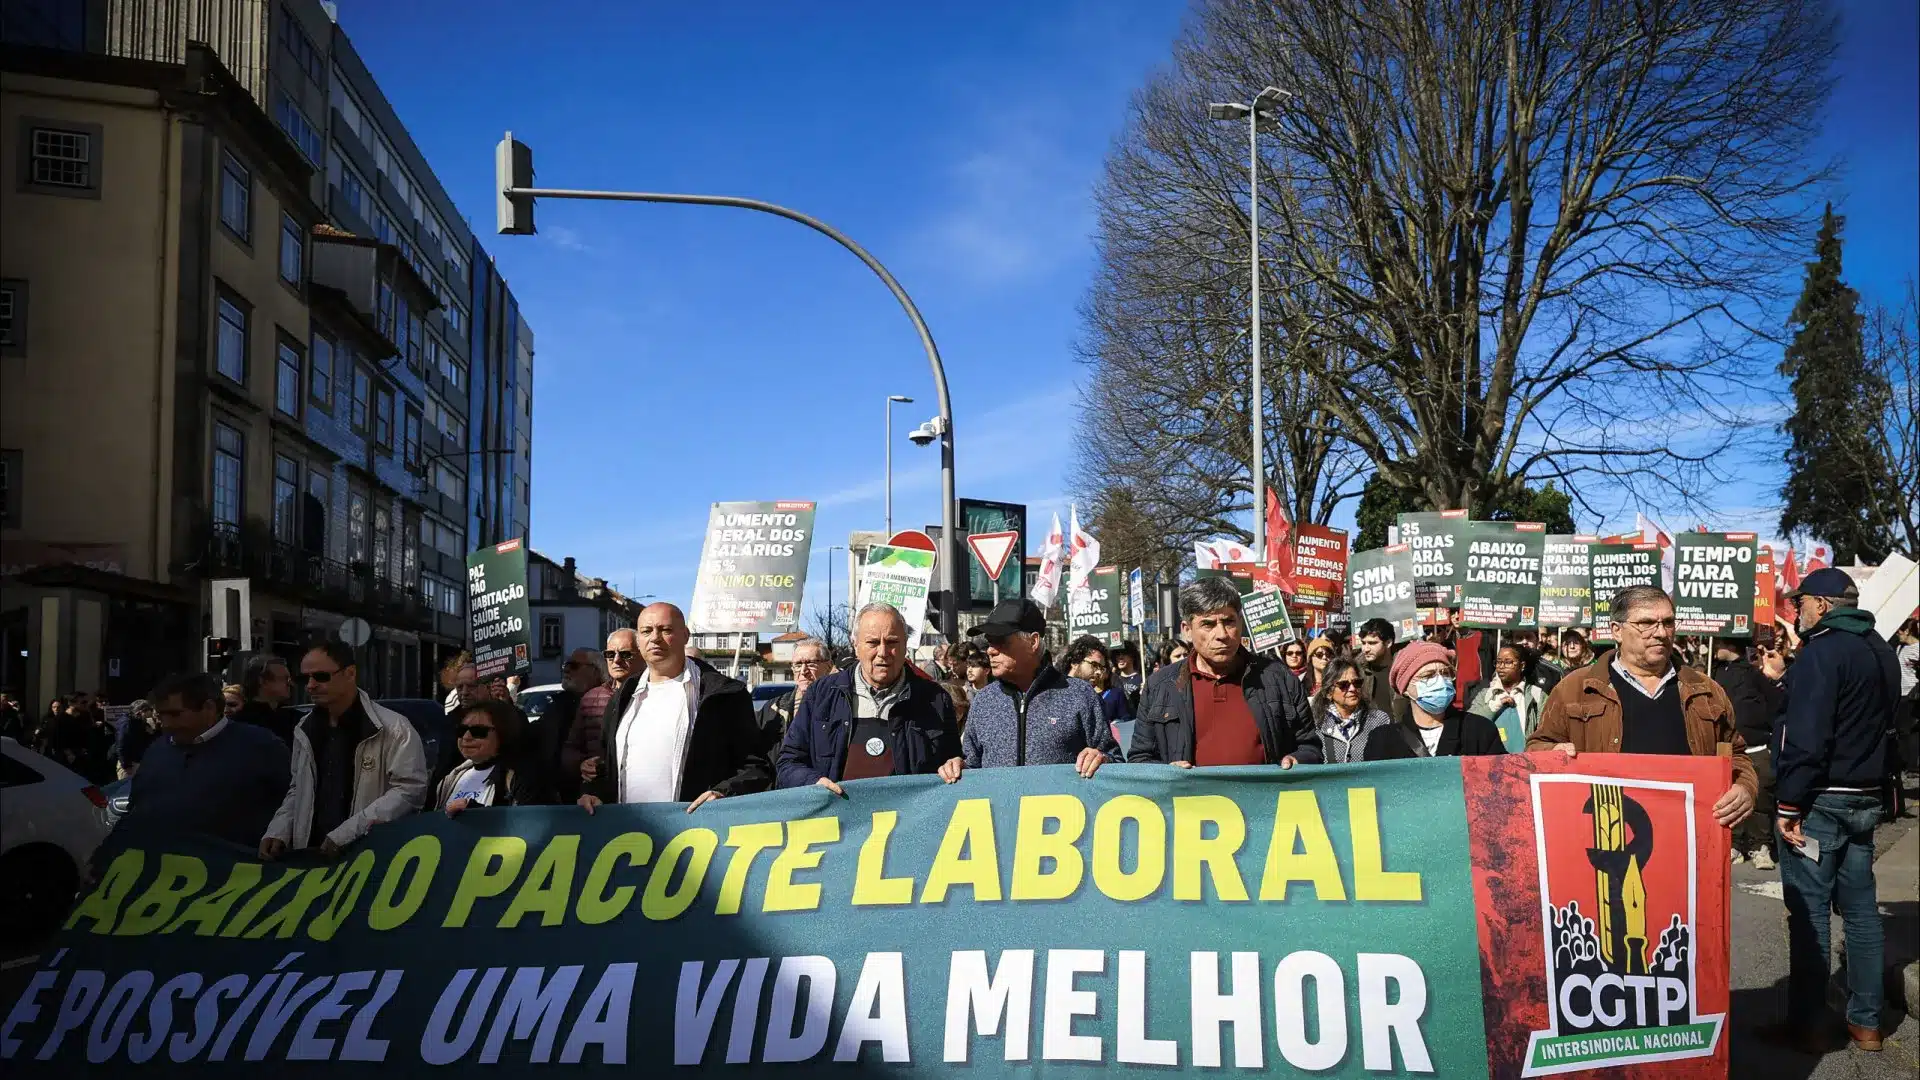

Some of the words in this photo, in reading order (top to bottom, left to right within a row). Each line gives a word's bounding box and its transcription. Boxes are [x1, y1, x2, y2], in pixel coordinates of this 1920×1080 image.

[718, 514, 796, 526] AUMENTO
[770, 529, 804, 541] DOS
[1402, 523, 1419, 535] 35
[708, 541, 794, 556] SALÁRIOS
[1299, 536, 1340, 550] AUMENTO
[1469, 542, 1526, 555] ABAIXO
[1544, 544, 1588, 554] MENTO
[1298, 546, 1316, 556] DAS
[1413, 549, 1444, 562] ARA
[1593, 553, 1649, 564] AUMENTO
[1680, 546, 1752, 563] TEMPO
[1297, 556, 1343, 571] REFORMAS
[1414, 563, 1454, 577] ODOS
[1468, 556, 1478, 568] O
[1481, 556, 1539, 570] PACOTE
[1756, 564, 1769, 573] DE
[469, 564, 484, 580] PAZ
[1296, 567, 1302, 575] E
[1304, 568, 1342, 581] PENSÕES
[1353, 565, 1394, 588] SMN
[1466, 569, 1536, 585] LABORAL
[1593, 566, 1632, 577] GERAL
[1634, 565, 1657, 575] DOS
[1678, 564, 1735, 580] PARA
[470, 579, 486, 596] PÃO
[760, 575, 794, 587] 150€
[1594, 575, 1652, 588] SALÁRIOS
[472, 583, 524, 611] HABITAÇÃO
[1353, 581, 1411, 608] 1050€
[1569, 588, 1590, 597] 150€
[1594, 590, 1616, 600] 15%
[1678, 582, 1738, 599] VIVER
[738, 601, 772, 610] MELHOR
[1244, 594, 1274, 608] AUMENTO
[1245, 604, 1267, 615] GERAL
[1266, 599, 1280, 608] DOS
[473, 607, 500, 626] SAÚDE
[1070, 613, 1109, 627] TODOS
[1247, 606, 1279, 621] SALÁRIOS
[474, 616, 522, 642] EDUCAÇÃO
[494, 647, 512, 658] MELHOR
[63, 848, 376, 942] ABAIXO
[368, 834, 441, 932] O
[442, 817, 840, 928] PACOTE
[851, 788, 1422, 905] LABORAL
[1, 948, 70, 1059] É
[34, 951, 404, 1063] POSSÍVEL
[1560, 973, 1688, 1028] CGTP
[420, 961, 639, 1066] UMA
[673, 952, 911, 1066] VIDA
[942, 949, 1435, 1072] MELHOR
[1542, 1036, 1640, 1060] INTERSINDICAL
[1644, 1030, 1704, 1050] NACIONAL
